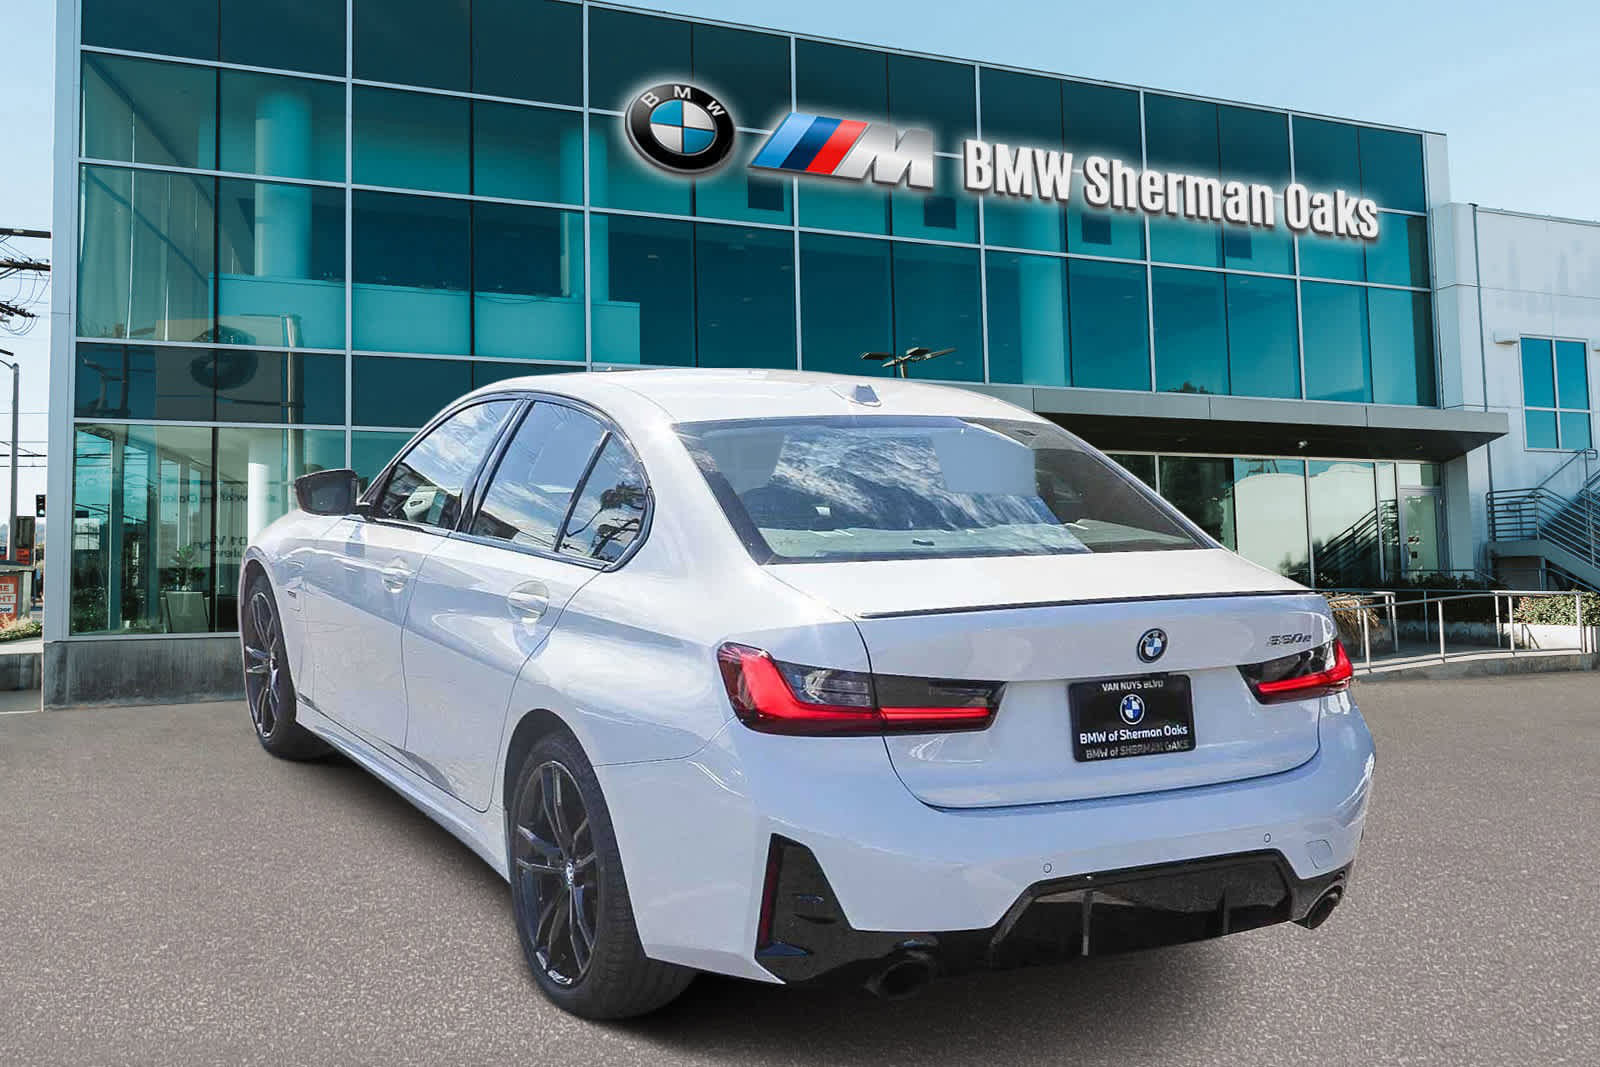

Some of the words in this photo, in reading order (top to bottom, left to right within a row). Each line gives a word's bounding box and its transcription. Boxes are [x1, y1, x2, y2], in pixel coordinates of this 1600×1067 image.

[963, 138, 1073, 203] BMW
[1083, 156, 1275, 229] Sherman
[1284, 183, 1379, 241] Oaks
[1102, 682, 1119, 692] VAN
[1120, 680, 1142, 690] NUYS
[1080, 731, 1106, 745] BMW
[1108, 730, 1118, 741] of
[1119, 728, 1162, 741] Sherman
[1163, 724, 1188, 736] Oaks
[1086, 747, 1108, 759] BMW
[1110, 747, 1118, 757] of
